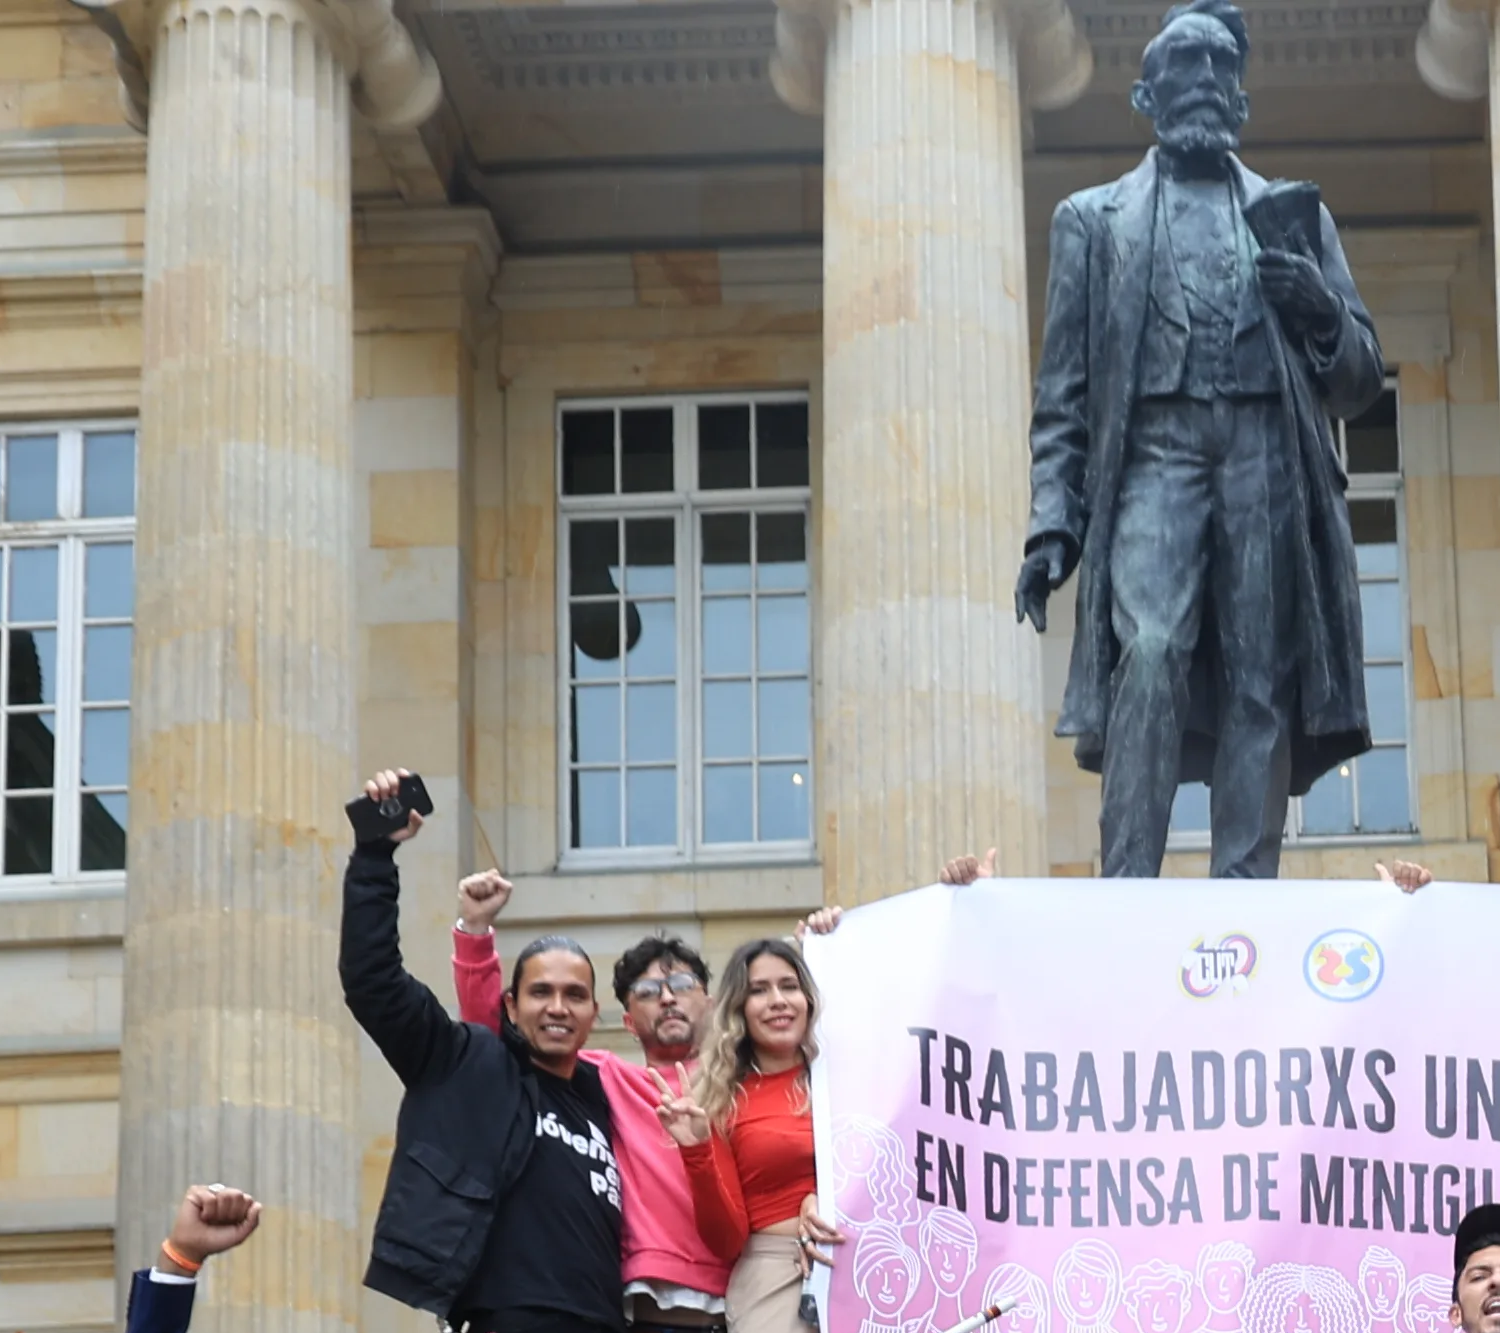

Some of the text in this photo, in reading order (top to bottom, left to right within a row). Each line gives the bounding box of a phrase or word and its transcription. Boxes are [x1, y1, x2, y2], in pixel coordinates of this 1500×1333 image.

[907, 1026, 1396, 1133] TRABAJADORXS
[915, 1130, 968, 1213] EN
[983, 1151, 1203, 1227] DEFENSA
[1223, 1152, 1281, 1222] DE
